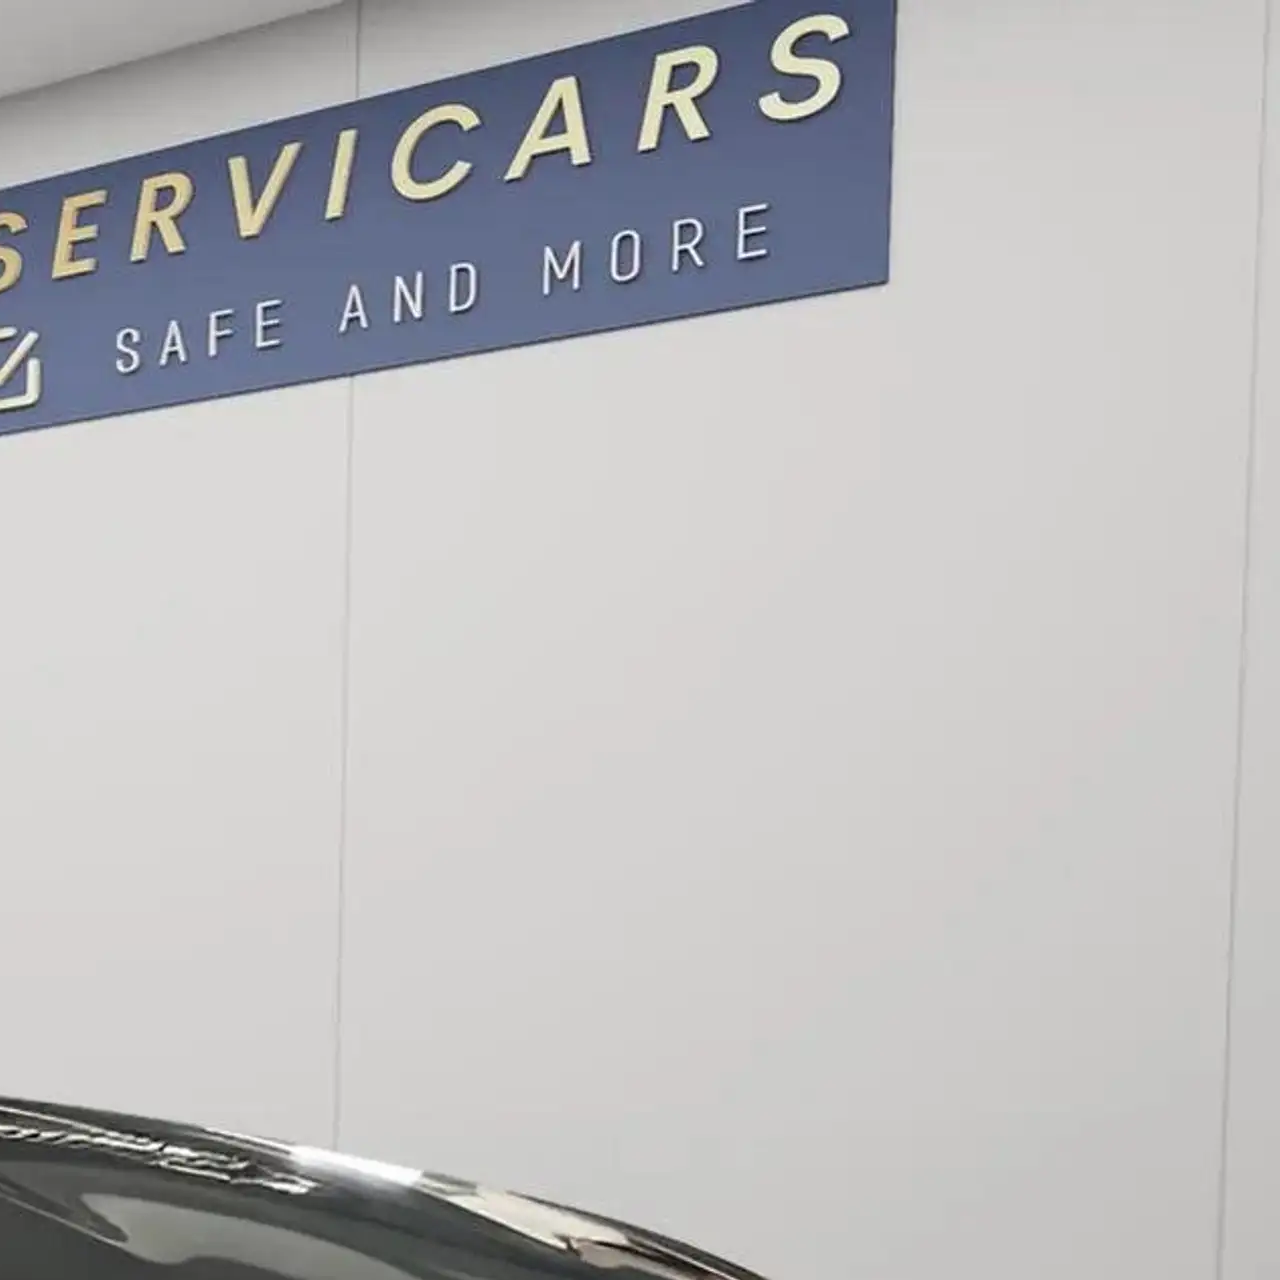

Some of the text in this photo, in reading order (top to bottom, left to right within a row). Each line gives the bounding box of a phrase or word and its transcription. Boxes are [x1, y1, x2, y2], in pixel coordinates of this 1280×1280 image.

[114, 202, 770, 375] SAFE AND MORE
